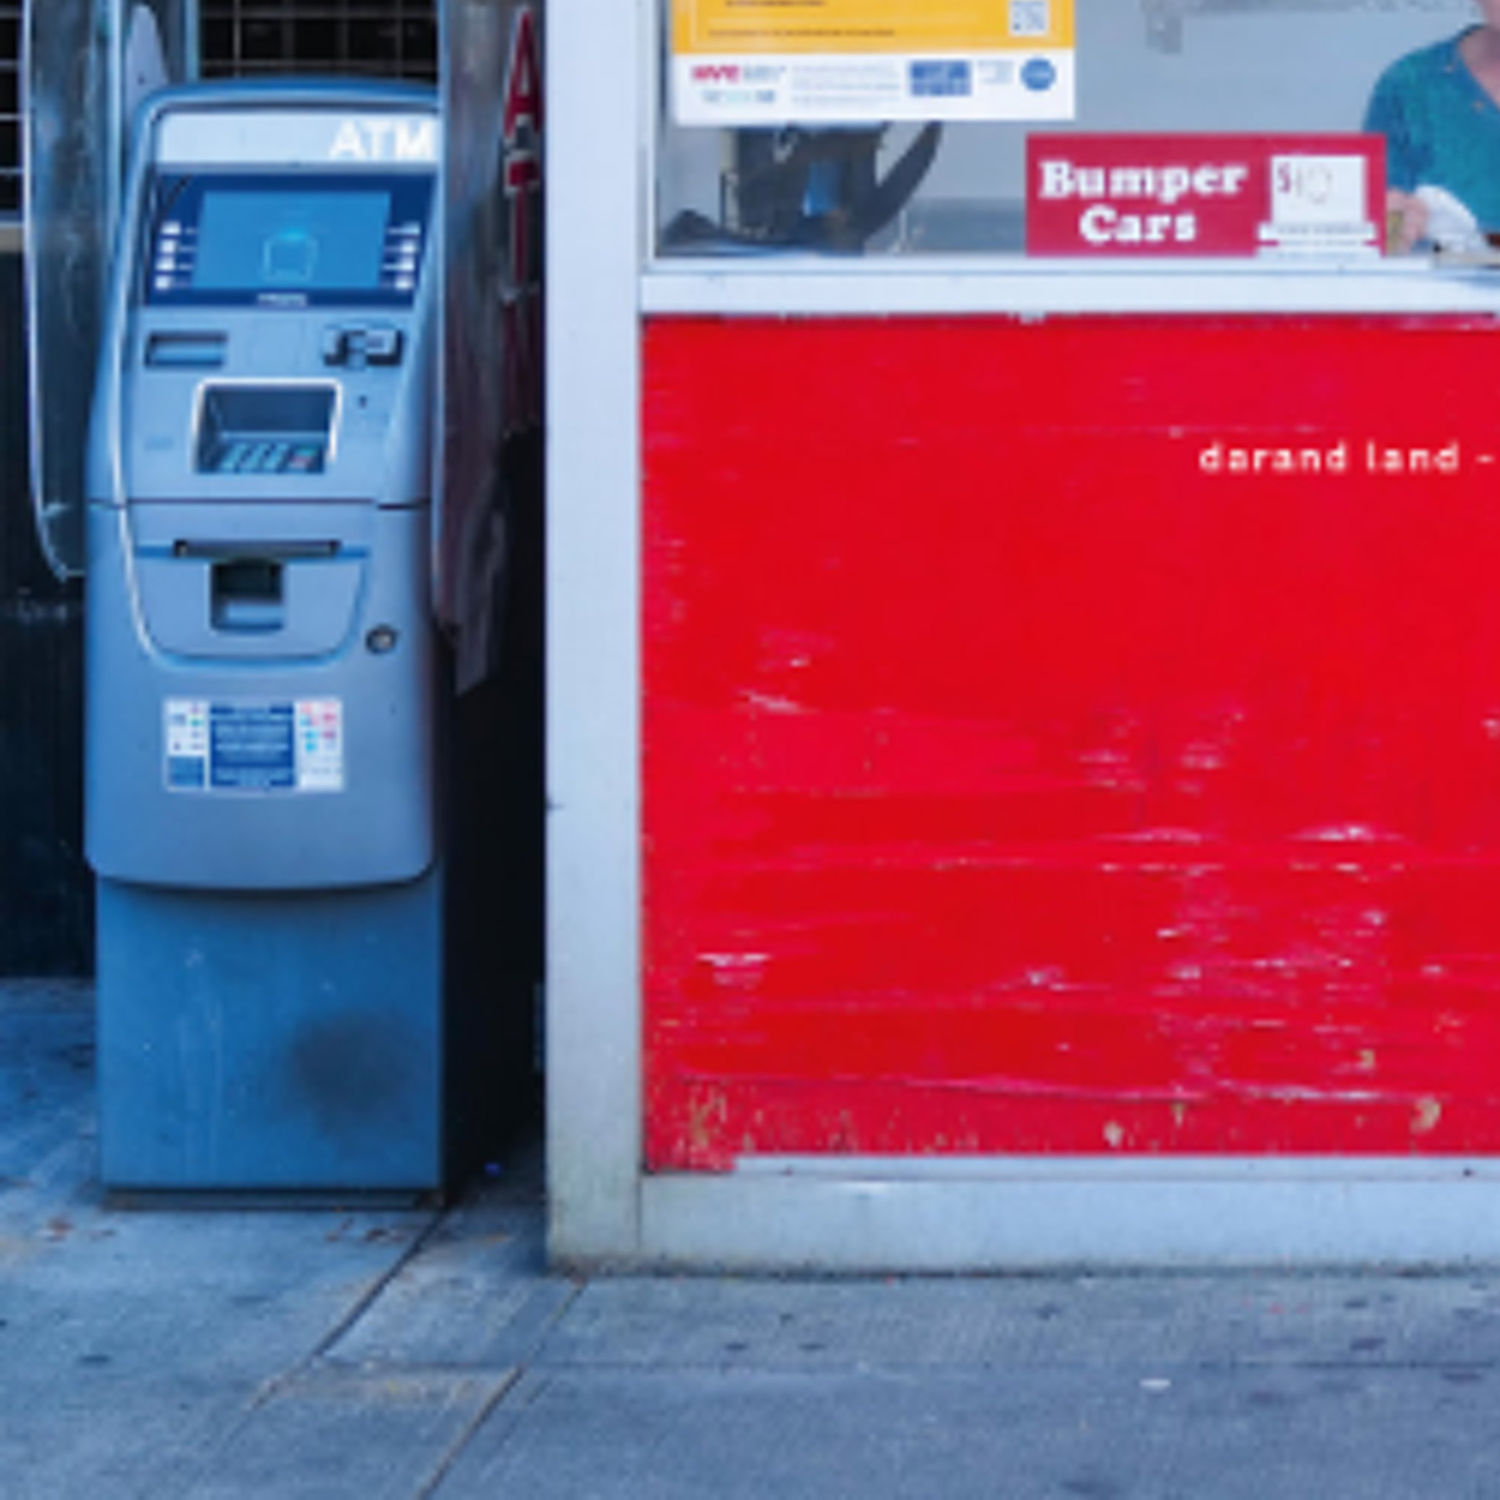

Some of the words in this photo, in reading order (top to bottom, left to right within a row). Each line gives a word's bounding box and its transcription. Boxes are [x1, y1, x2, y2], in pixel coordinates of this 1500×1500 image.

[328, 119, 436, 159] ATM
[1037, 158, 1250, 205] Bumper
[1078, 205, 1199, 244] Cars
